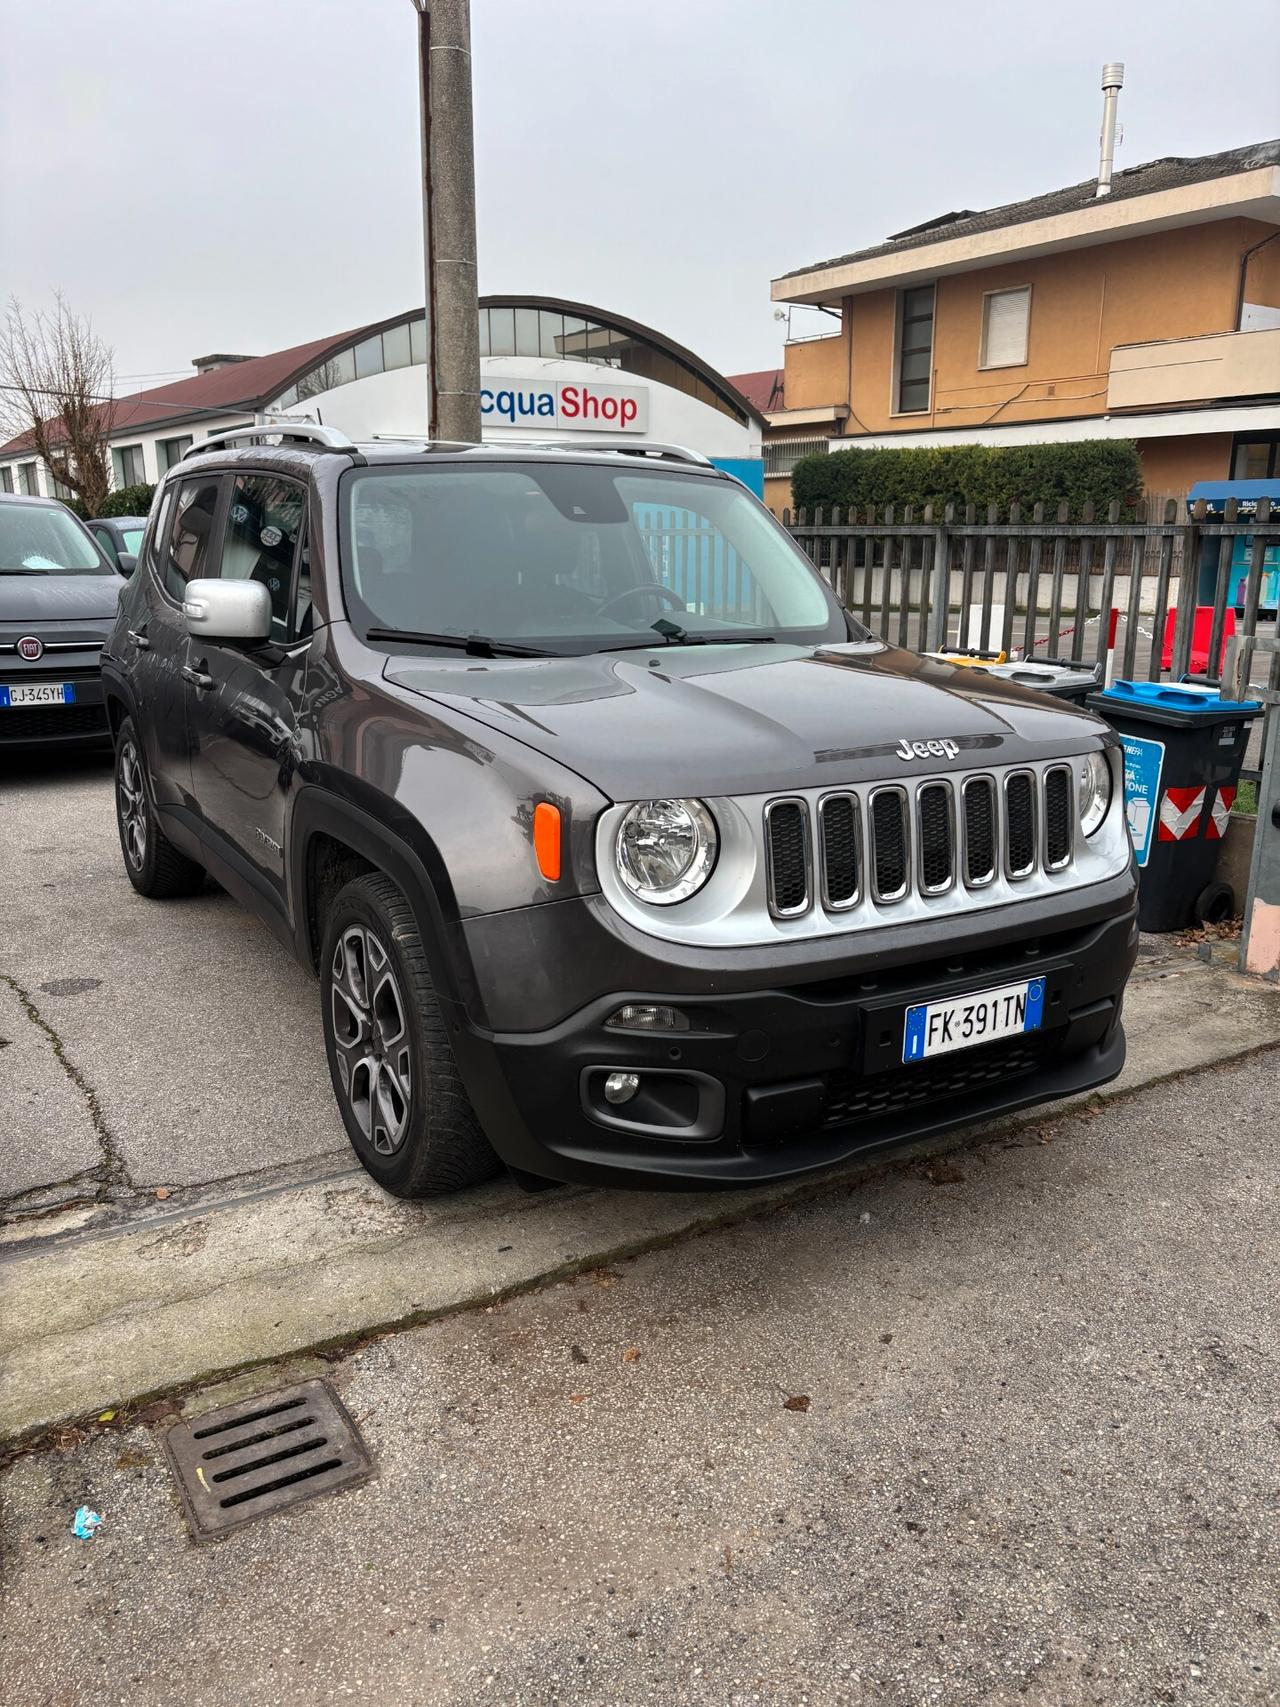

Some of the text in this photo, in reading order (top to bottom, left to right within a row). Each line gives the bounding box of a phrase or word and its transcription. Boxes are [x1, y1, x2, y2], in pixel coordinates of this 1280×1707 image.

[480, 387, 637, 428] cqua Shop
[23, 643, 38, 655] FIAT
[896, 739, 960, 761] Jeep
